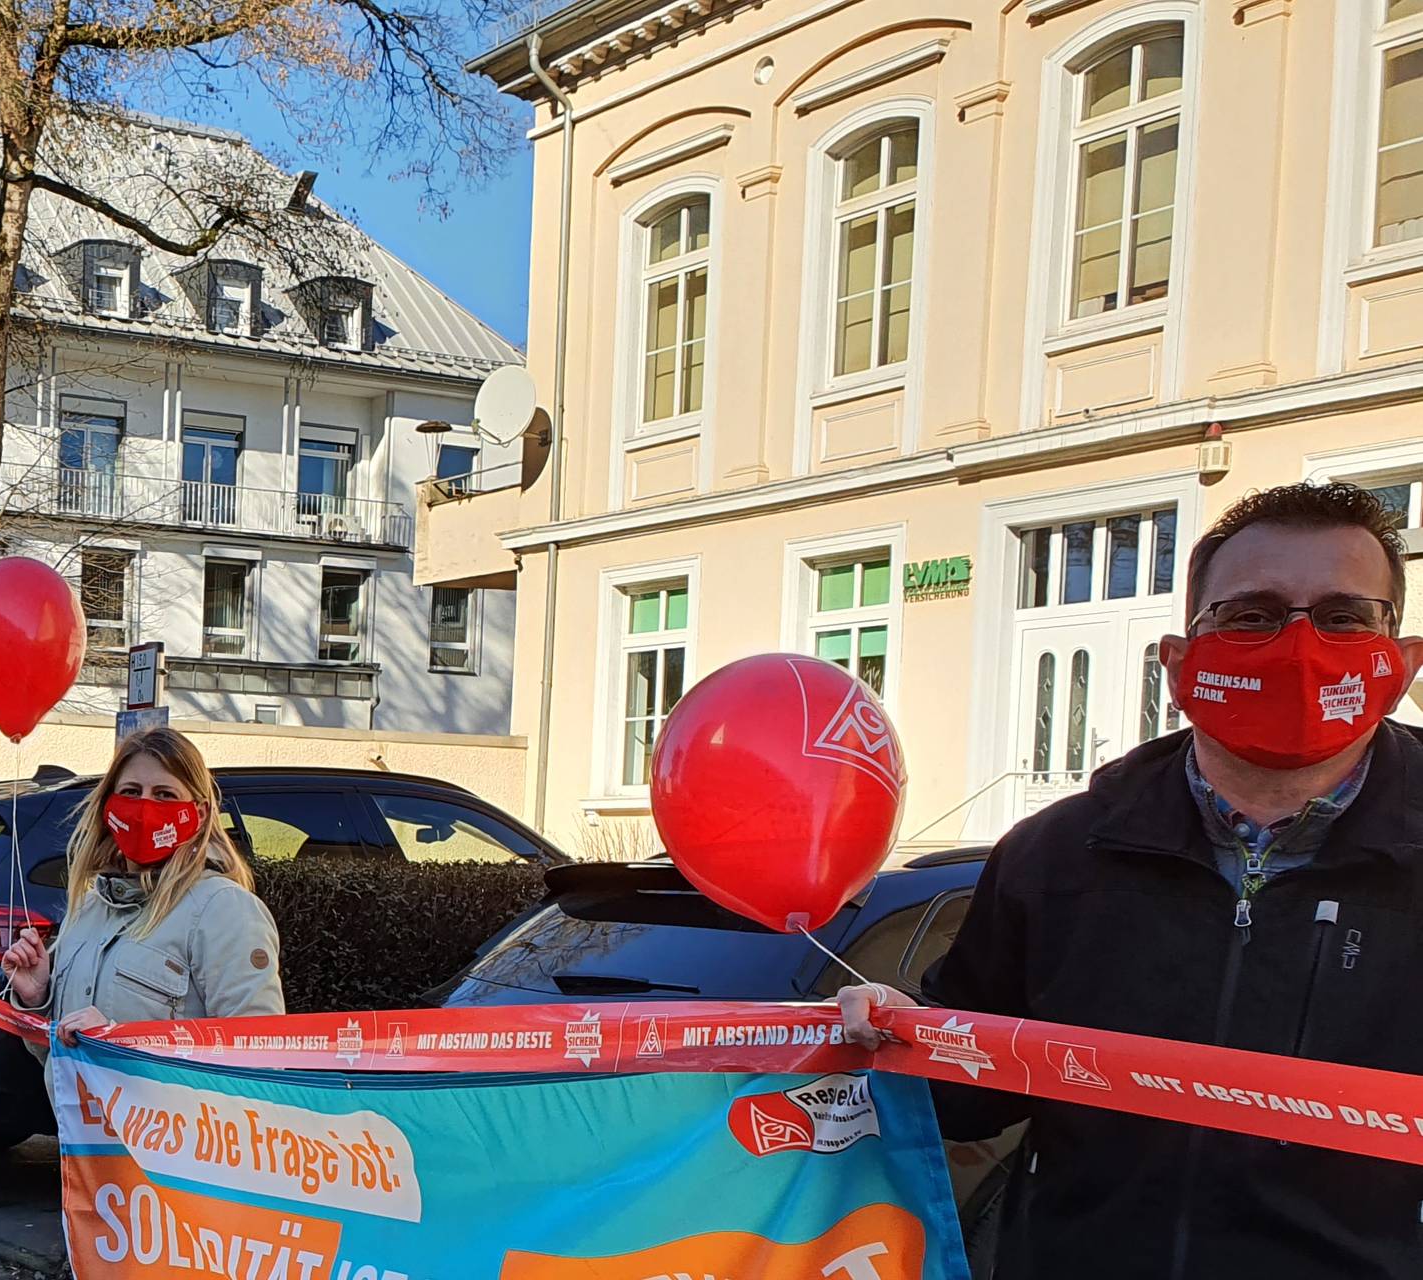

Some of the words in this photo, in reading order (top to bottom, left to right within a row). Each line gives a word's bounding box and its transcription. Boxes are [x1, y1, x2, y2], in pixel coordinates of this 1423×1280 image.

[903, 558, 948, 587] LVM
[1196, 671, 1262, 691] GEMEINSAM
[1321, 683, 1363, 698] ZUKUNFT
[1192, 686, 1227, 703] STARK.
[568, 1024, 598, 1034] ZUKUNFT
[682, 1027, 712, 1046] MIT
[714, 1025, 788, 1046] ABSTAND
[791, 1024, 826, 1045] DAS
[918, 1027, 974, 1048] ZUKUNFT
[233, 1035, 248, 1050] MIT
[248, 1035, 285, 1050] ABSTAND
[285, 1035, 302, 1050] DAS
[303, 1035, 329, 1050] BESTE
[417, 1034, 437, 1050] MIT
[438, 1033, 488, 1050] ABSTAND
[491, 1032, 514, 1049] DAS
[516, 1031, 553, 1049] BESTE
[1130, 1071, 1185, 1094] MIT
[1192, 1081, 1334, 1121] ABSTAND
[1338, 1104, 1410, 1134] DAS
[123, 1104, 187, 1155] was
[195, 1101, 242, 1168] die
[244, 1108, 339, 1195] Frage
[328, 1129, 402, 1193] ist:
